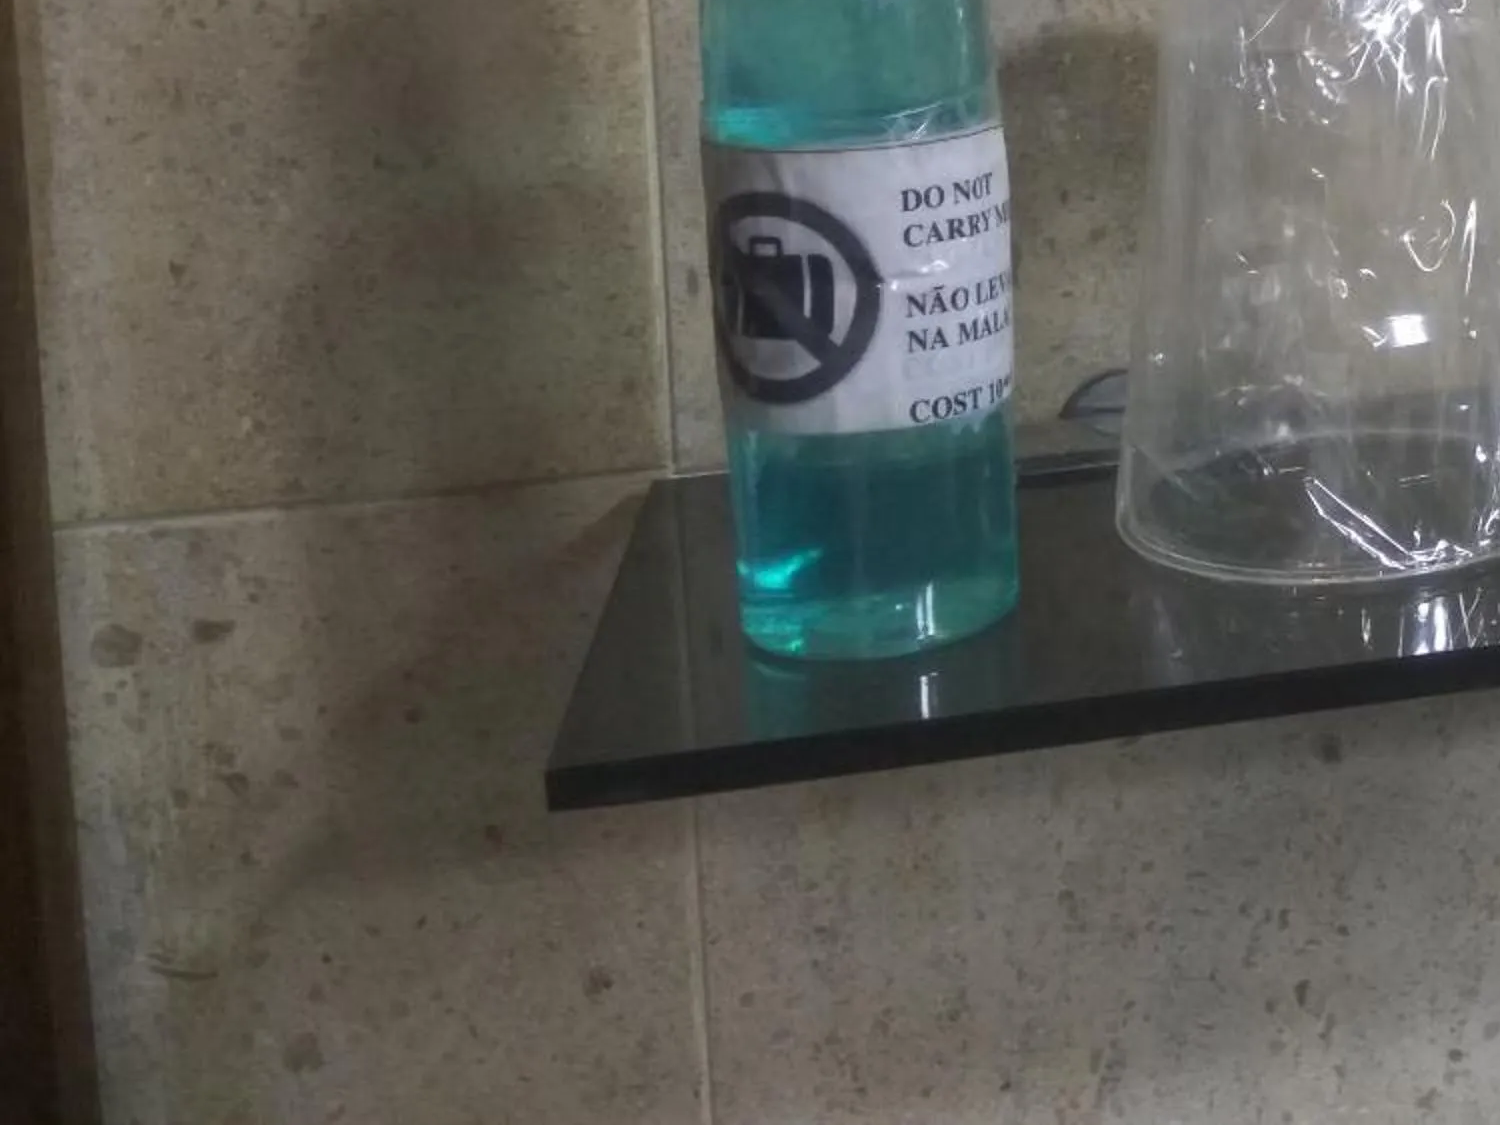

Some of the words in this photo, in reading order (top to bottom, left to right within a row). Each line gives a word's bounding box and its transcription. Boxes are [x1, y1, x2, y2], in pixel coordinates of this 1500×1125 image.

[900, 184, 945, 213] DO
[951, 171, 993, 205] NOT
[903, 207, 992, 248] CARRY
[905, 283, 970, 318] NÃO
[974, 271, 1011, 306] LEV
[906, 325, 950, 353] NA
[909, 386, 984, 424] COST
